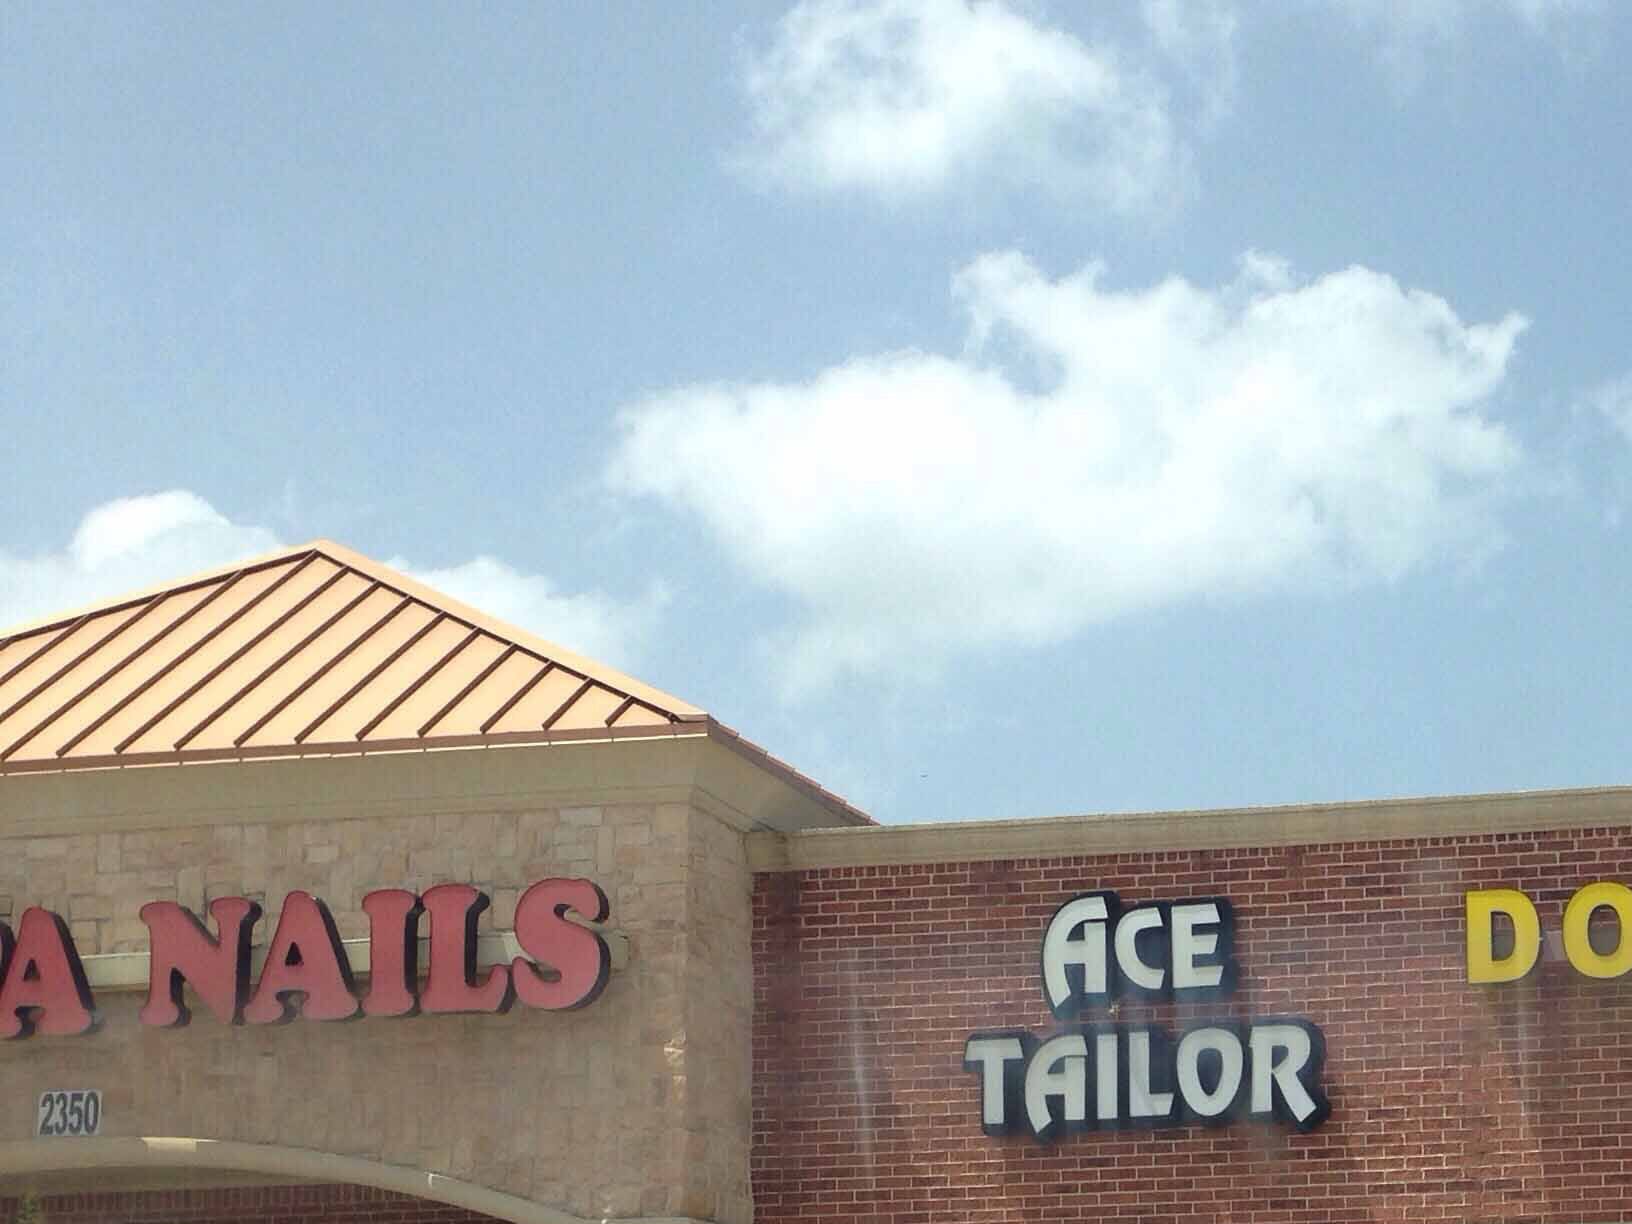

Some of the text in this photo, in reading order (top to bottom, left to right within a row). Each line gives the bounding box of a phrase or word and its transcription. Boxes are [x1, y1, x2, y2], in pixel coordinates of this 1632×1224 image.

[0, 877, 609, 1037] A NAILS
[1042, 895, 1224, 1008] ACE
[40, 1092, 99, 1135] 2350
[963, 1024, 1317, 1134] TAILOR
